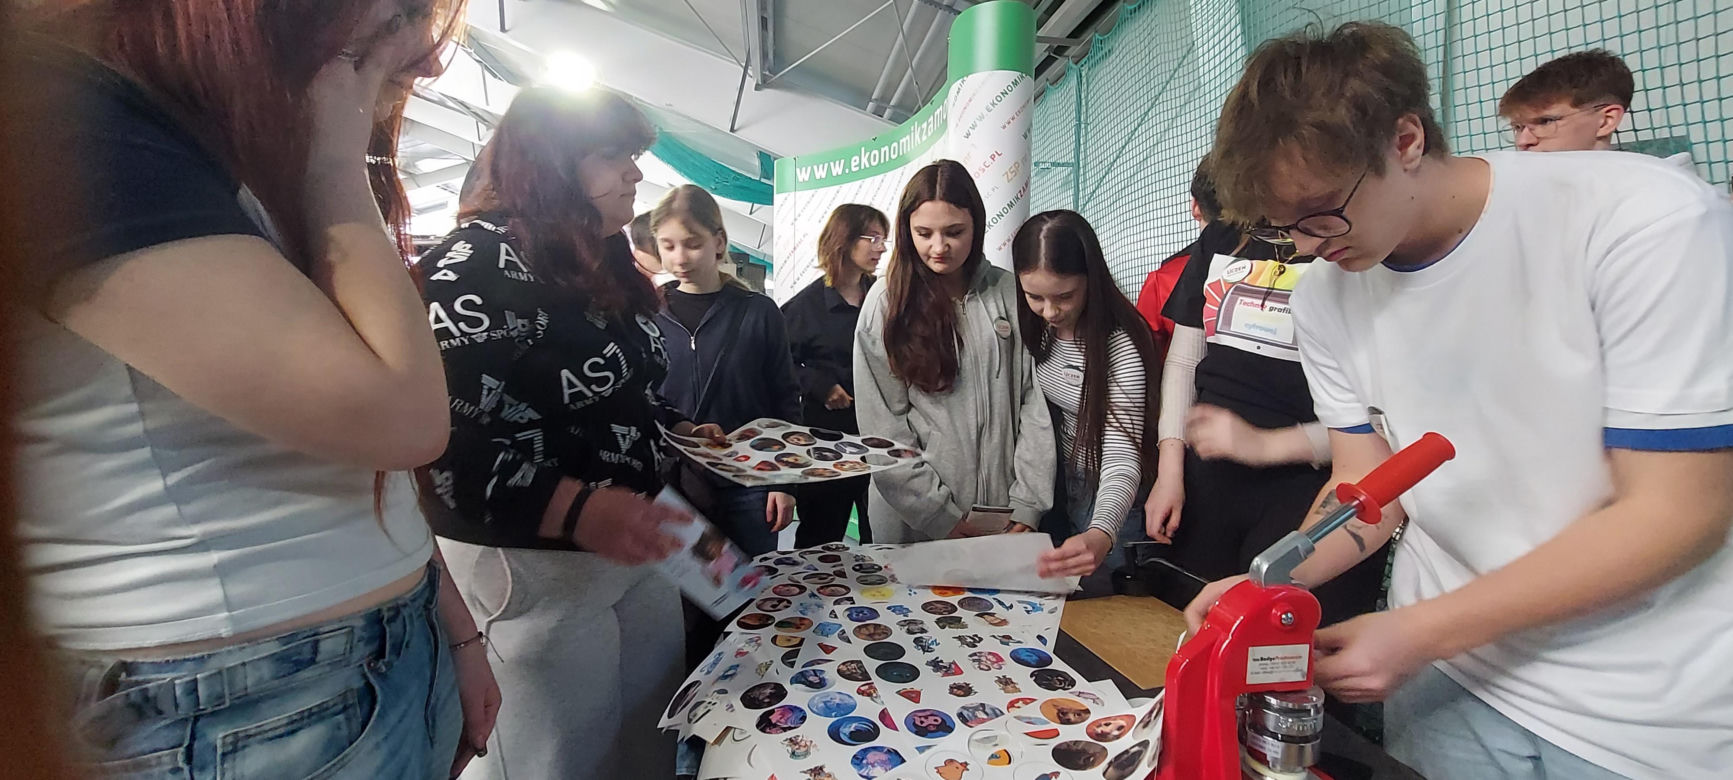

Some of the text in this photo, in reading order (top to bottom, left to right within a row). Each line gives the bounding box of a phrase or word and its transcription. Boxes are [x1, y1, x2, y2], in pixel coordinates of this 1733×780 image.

[428, 294, 490, 337] AS
[440, 336, 470, 350] RMY
[560, 356, 616, 404] AS
